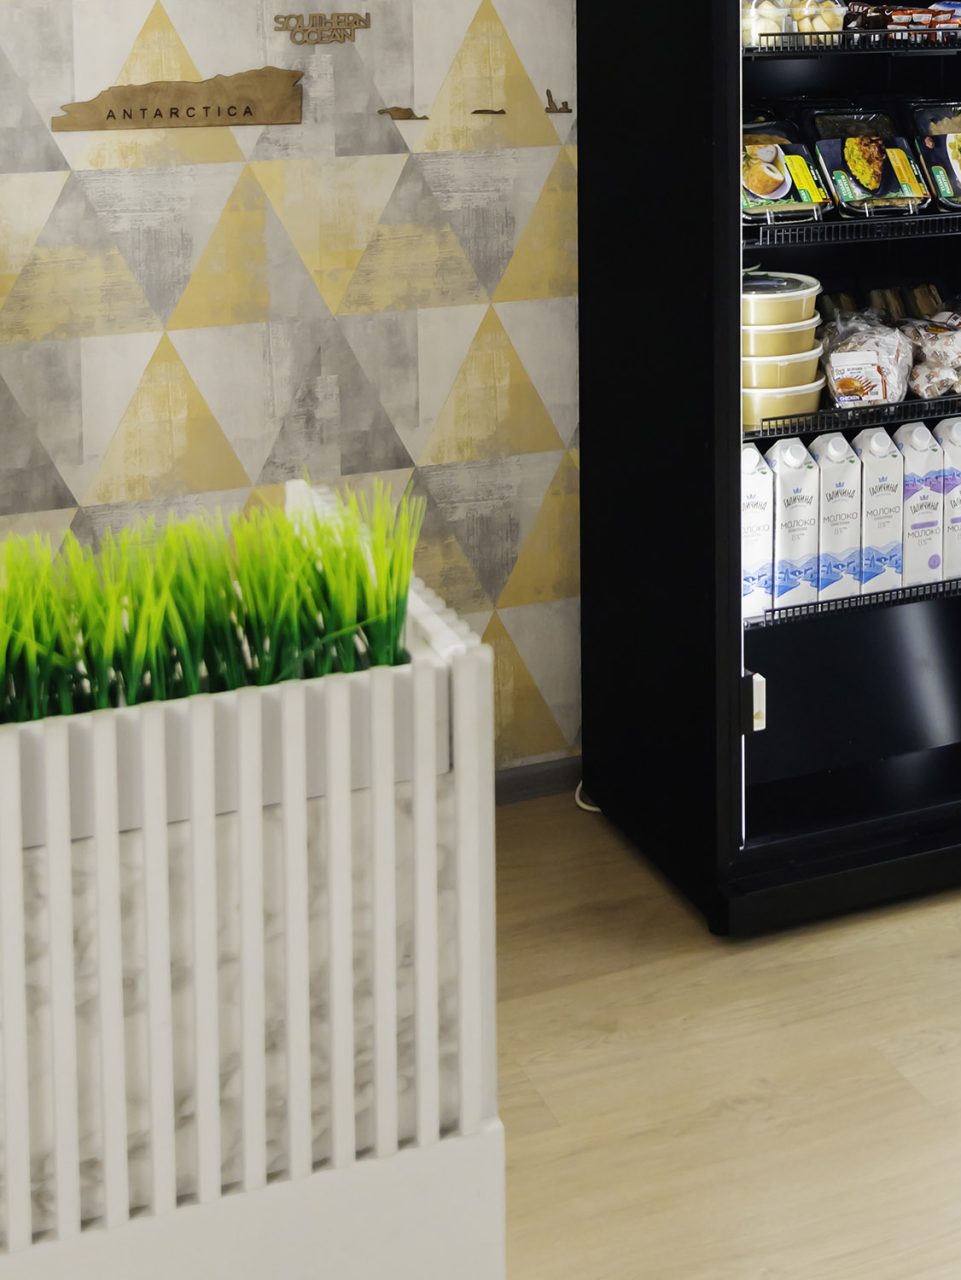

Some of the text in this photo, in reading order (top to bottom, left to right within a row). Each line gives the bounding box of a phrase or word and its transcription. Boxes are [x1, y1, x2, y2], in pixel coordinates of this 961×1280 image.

[273, 12, 371, 32] SOUTHERN
[290, 28, 356, 45] OCEAN
[106, 105, 253, 120] ANTARCTICA
